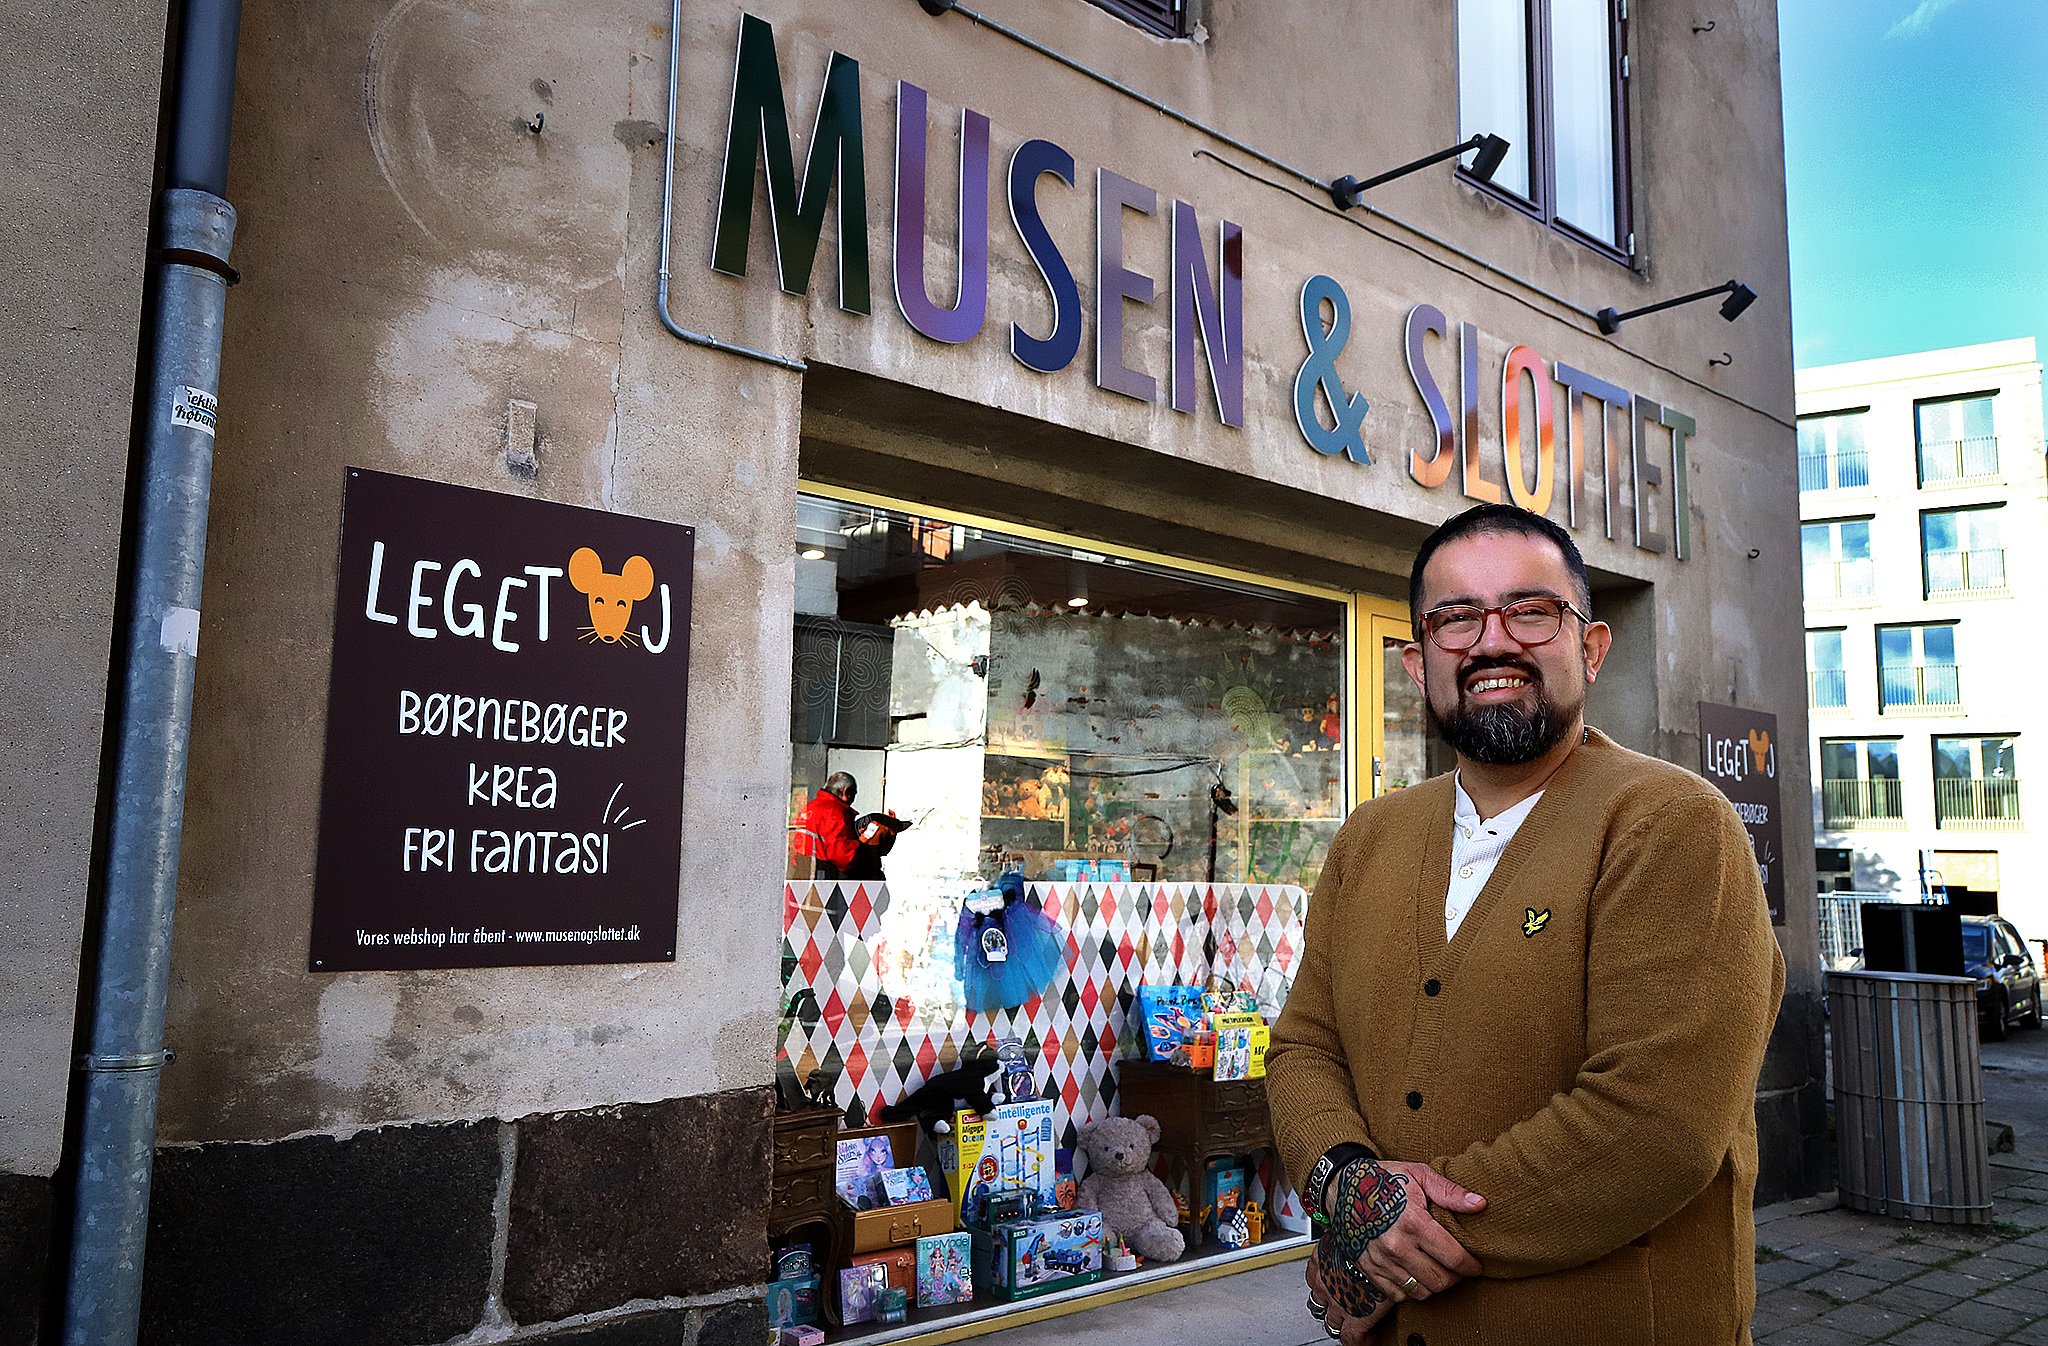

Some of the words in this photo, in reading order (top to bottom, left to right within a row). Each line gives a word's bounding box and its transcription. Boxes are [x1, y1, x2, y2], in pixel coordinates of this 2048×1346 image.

[711, 12, 1243, 430] MUSEN
[1294, 274, 1371, 466] &
[1405, 303, 1696, 561] SLOTTET
[402, 827, 455, 873] FRI
[356, 929, 390, 946] Vores
[393, 928, 446, 948] webshop
[450, 927, 470, 945] har
[473, 927, 507, 944] åbent
[515, 925, 641, 945] www.musenogslottet.dk
[999, 1104, 1051, 1120] intelligente
[961, 1124, 984, 1135] Migoga
[962, 1134, 985, 1144] Ocean
